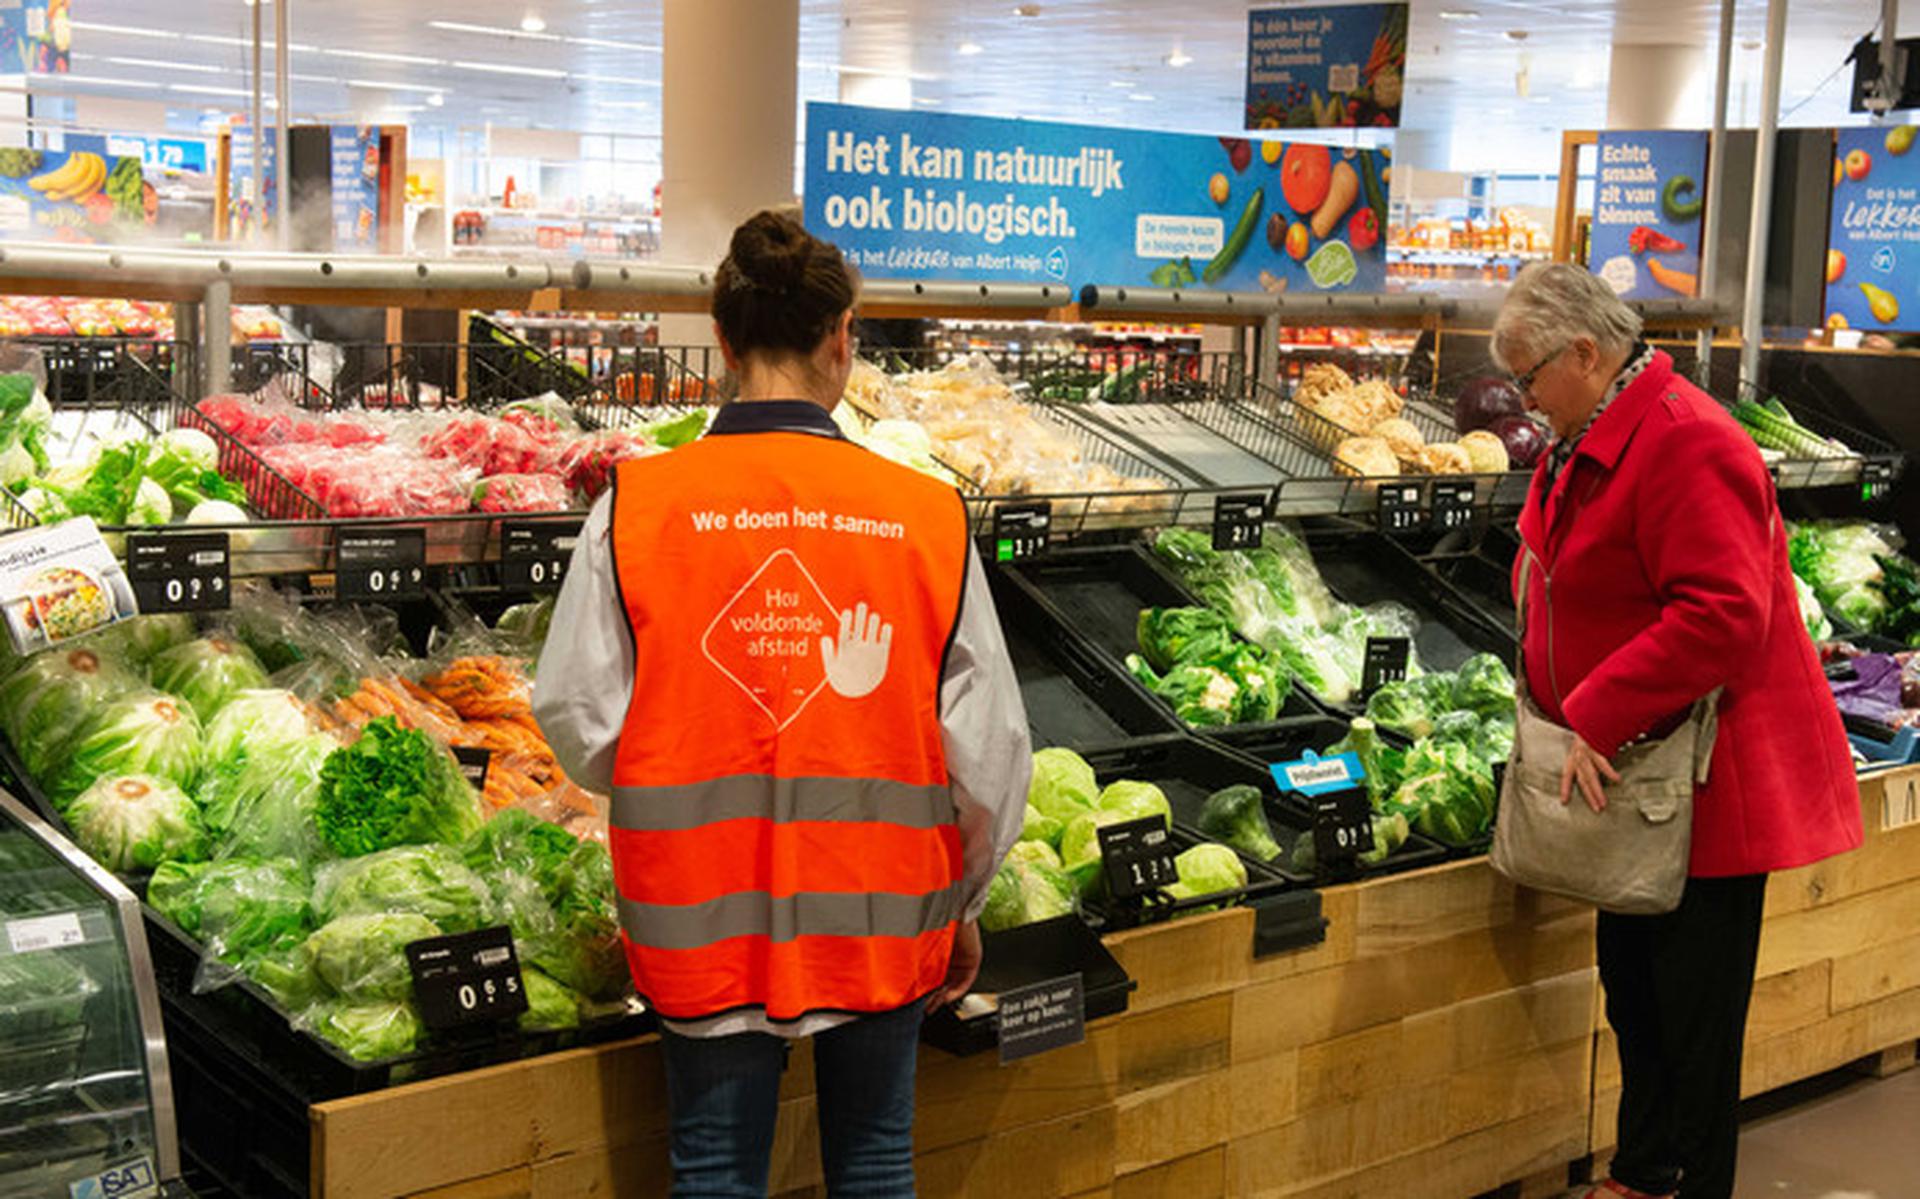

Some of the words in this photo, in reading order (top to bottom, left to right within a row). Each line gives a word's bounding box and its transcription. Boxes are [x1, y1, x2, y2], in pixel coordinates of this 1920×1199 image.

[827, 131, 891, 175] Het
[901, 133, 963, 179] kan
[974, 146, 1124, 197] natuurlijk
[1602, 143, 1650, 163] Echte
[1601, 163, 1657, 183] smaak
[1600, 184, 1621, 204] zit
[1625, 187, 1656, 203] van
[824, 186, 892, 229] ook
[903, 188, 1076, 244] biologisch.
[691, 511, 727, 532] We
[734, 508, 788, 529] doen
[793, 506, 828, 529] het
[833, 513, 904, 539] samen
